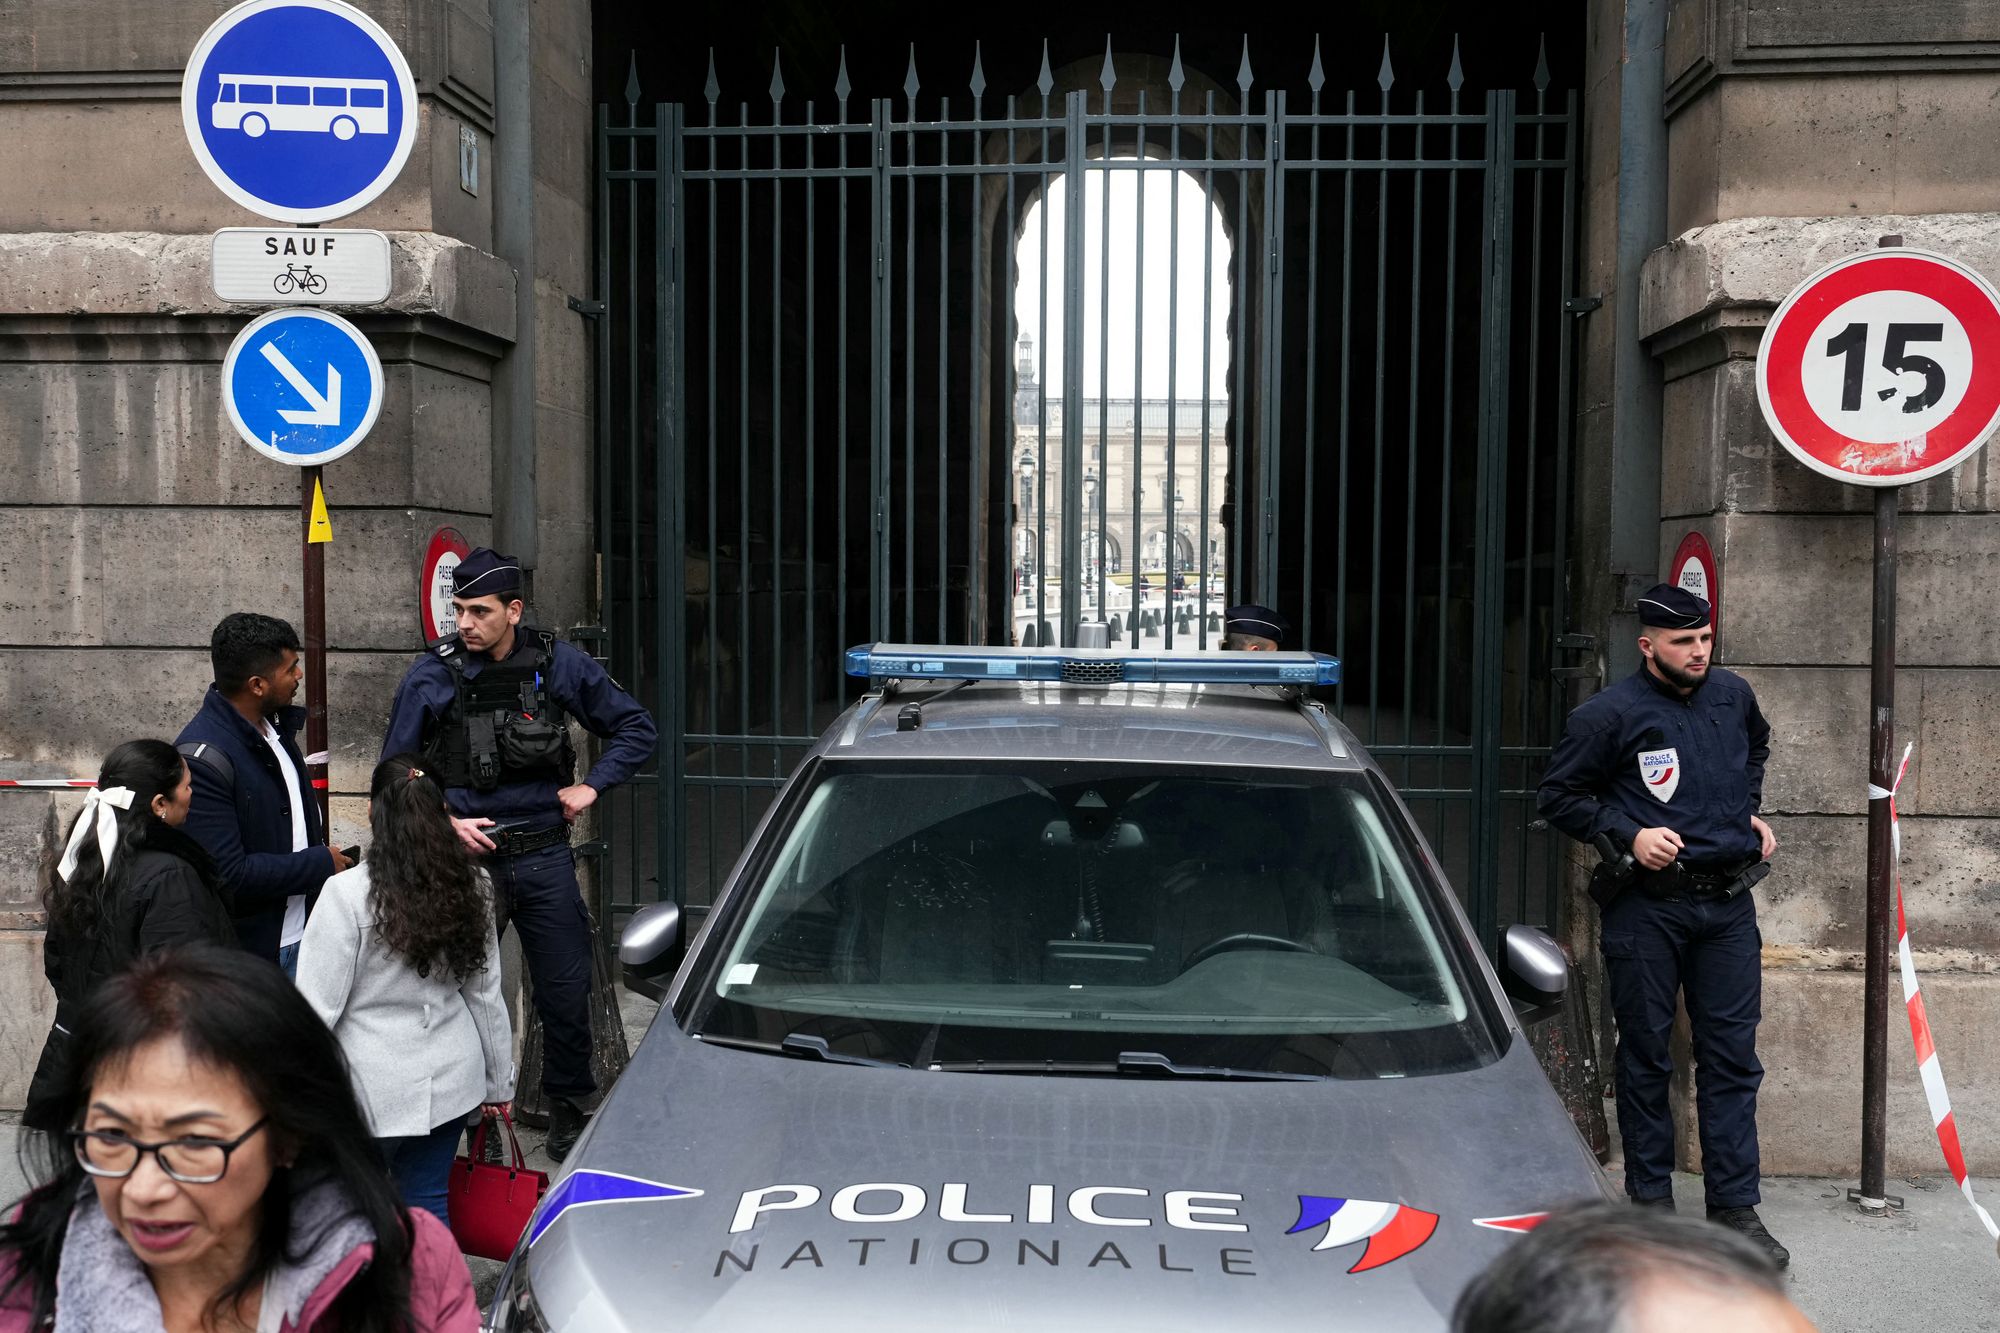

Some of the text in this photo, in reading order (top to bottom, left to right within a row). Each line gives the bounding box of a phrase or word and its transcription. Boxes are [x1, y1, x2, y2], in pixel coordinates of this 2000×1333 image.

[265, 237, 335, 256] SAUF
[1826, 322, 1946, 414] 15
[439, 565, 454, 580] PASS
[1683, 572, 1702, 587] PASSAGE
[439, 585, 453, 599] INTER
[440, 618, 457, 635] PIÉTON
[1643, 758, 1674, 766] NATIONALE
[1645, 753, 1670, 761] POLICE
[728, 1182, 1250, 1234] POLICE
[713, 1238, 1257, 1277] NATIONALE
